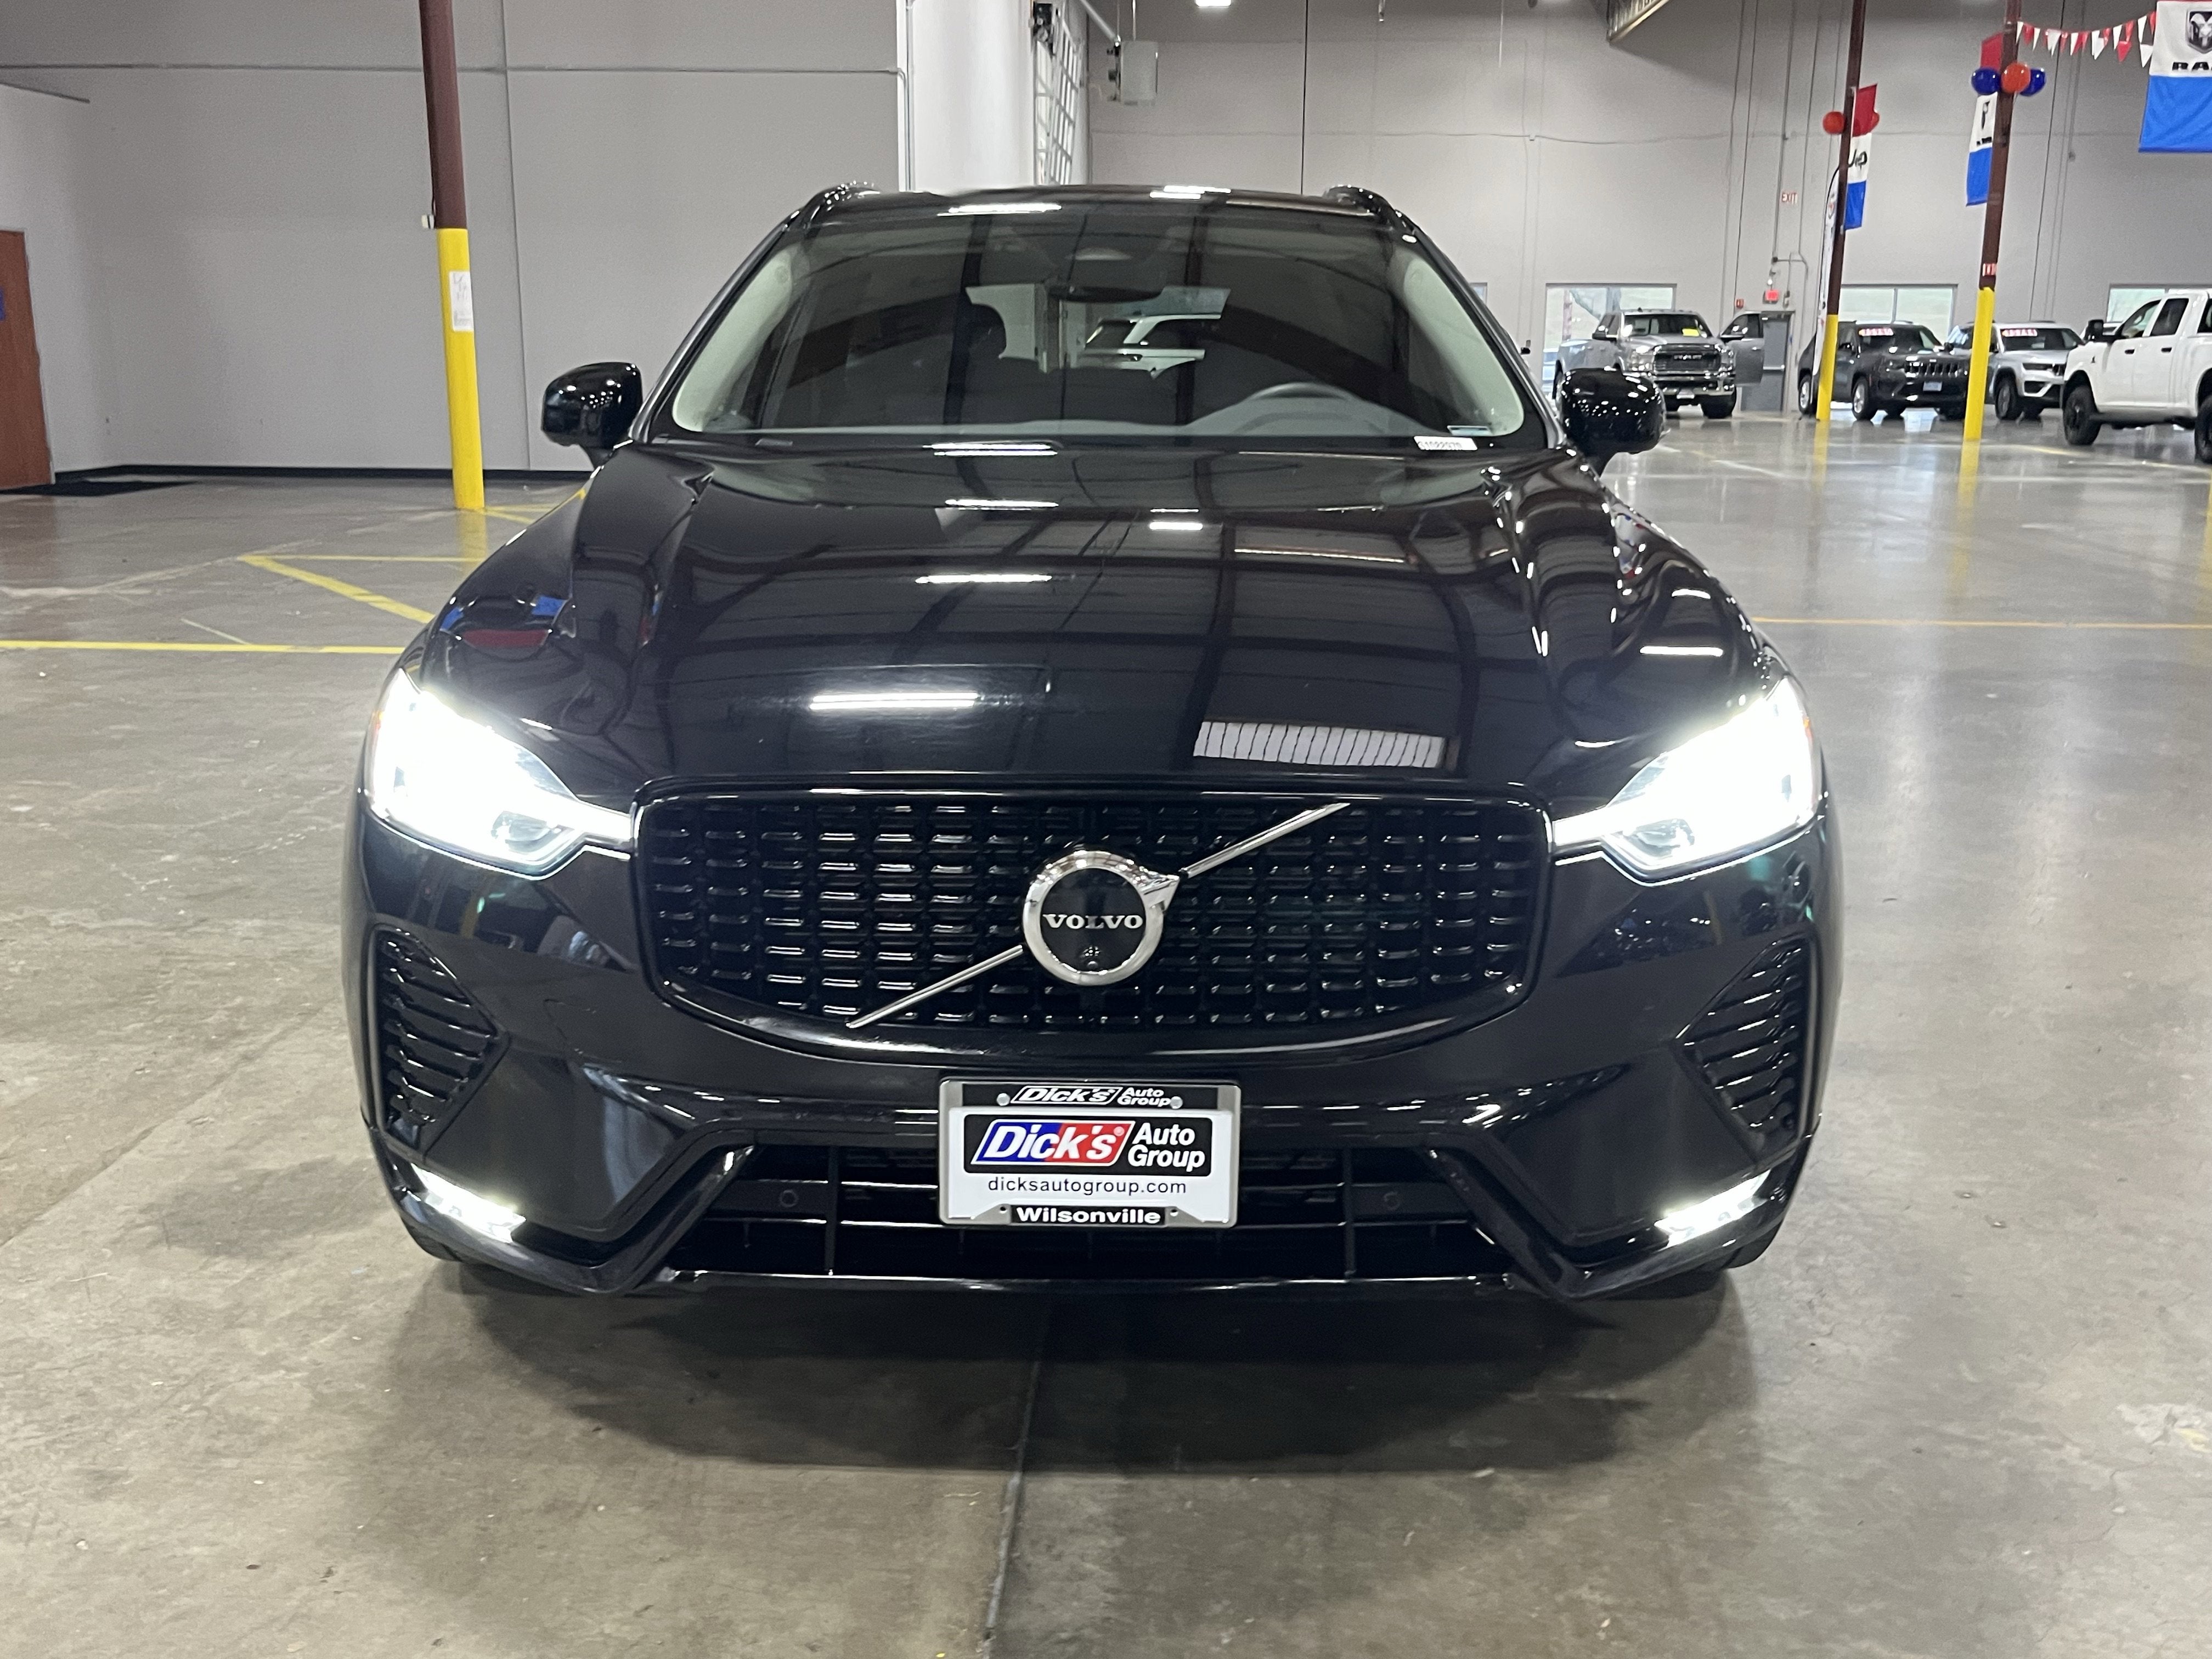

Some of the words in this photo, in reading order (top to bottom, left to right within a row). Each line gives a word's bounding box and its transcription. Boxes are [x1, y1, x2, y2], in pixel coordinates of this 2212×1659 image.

[2172, 61, 2212, 71] RA
[1042, 914, 1143, 929] VOLVO
[1019, 1088, 1111, 1103] Dick's
[1122, 1087, 1164, 1097] Auto
[1117, 1096, 1171, 1107] Group
[1132, 1122, 1195, 1146] Auto
[983, 1125, 1117, 1160] Dick's
[1127, 1144, 1205, 1172] Group
[988, 1177, 1186, 1196] dicksautogroup.com
[1016, 1207, 1161, 1224] Wilsonville
